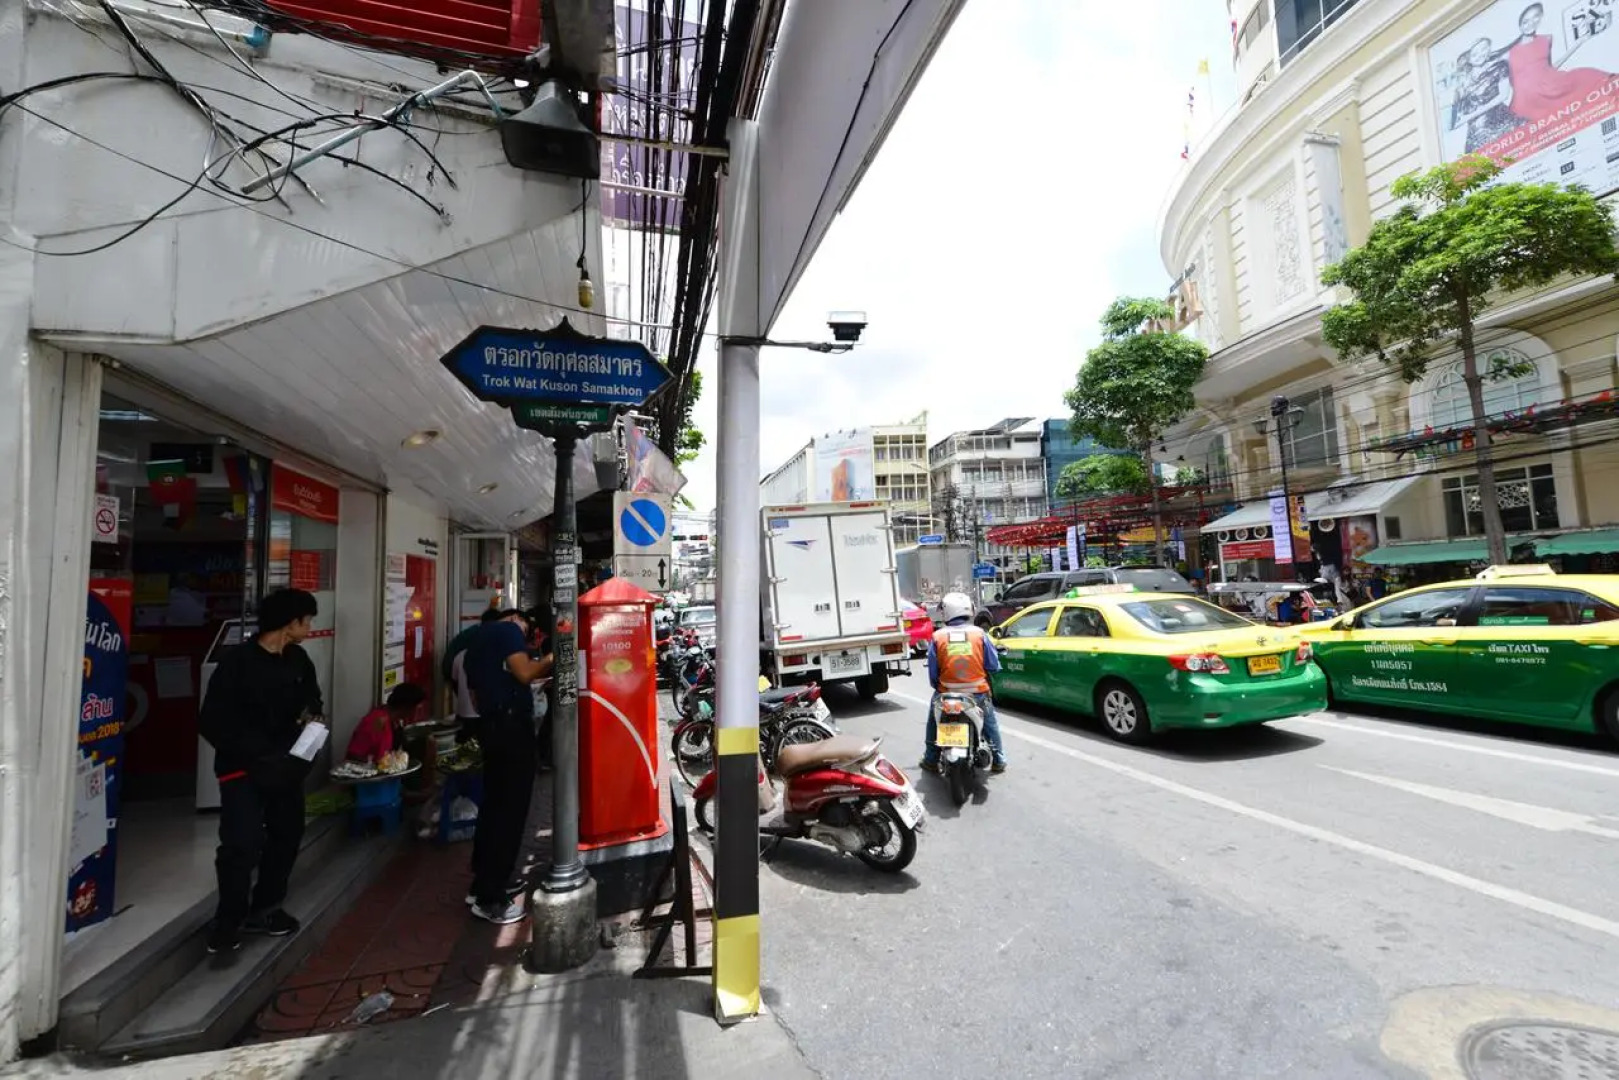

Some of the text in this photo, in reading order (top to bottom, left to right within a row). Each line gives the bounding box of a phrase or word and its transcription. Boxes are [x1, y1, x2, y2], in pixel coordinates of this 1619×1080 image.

[1529, 101, 1581, 134] BRAND
[484, 341, 642, 379] ตรอกวัดกุศลสมาคร
[482, 374, 642, 397] Trok Wat Kuson Samakhon
